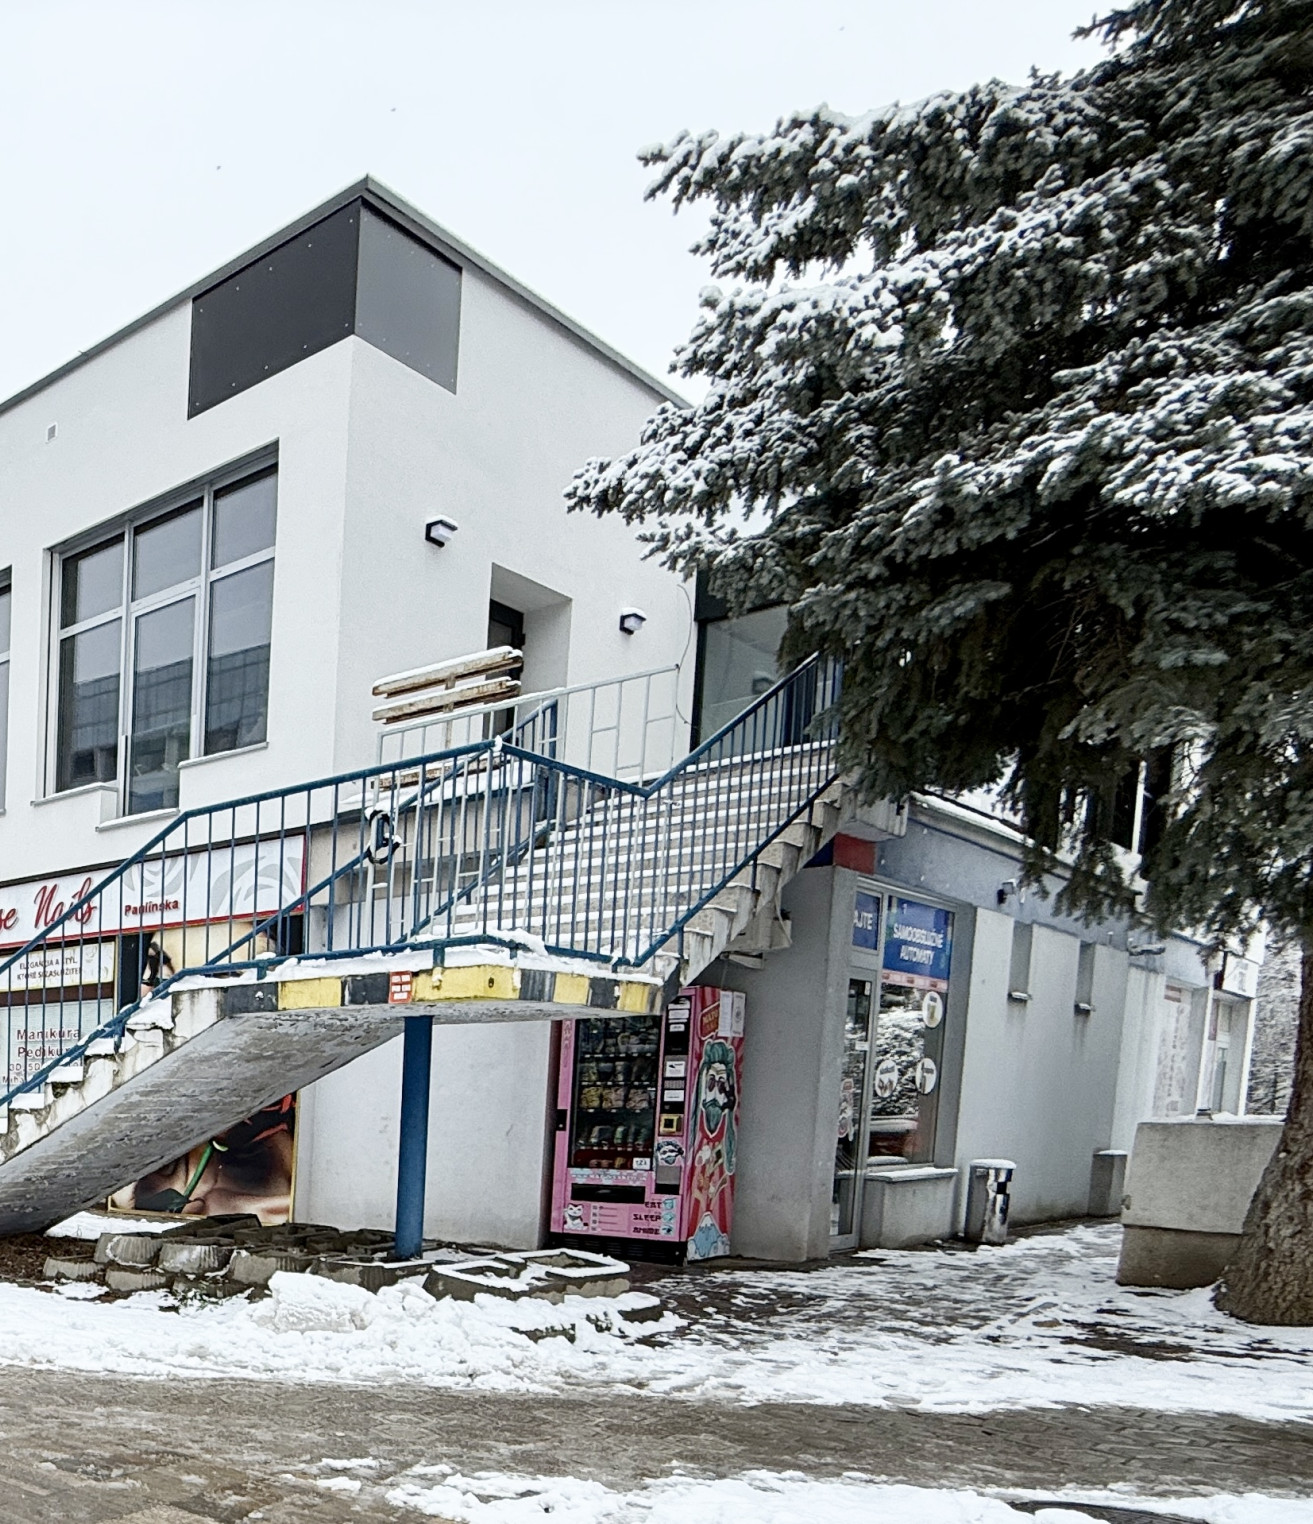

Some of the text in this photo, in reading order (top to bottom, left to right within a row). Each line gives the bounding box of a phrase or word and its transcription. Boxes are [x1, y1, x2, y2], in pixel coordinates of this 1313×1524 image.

[34, 876, 98, 929] Nails
[644, 1201, 662, 1209] EAT
[633, 1213, 662, 1222] SLEEP
